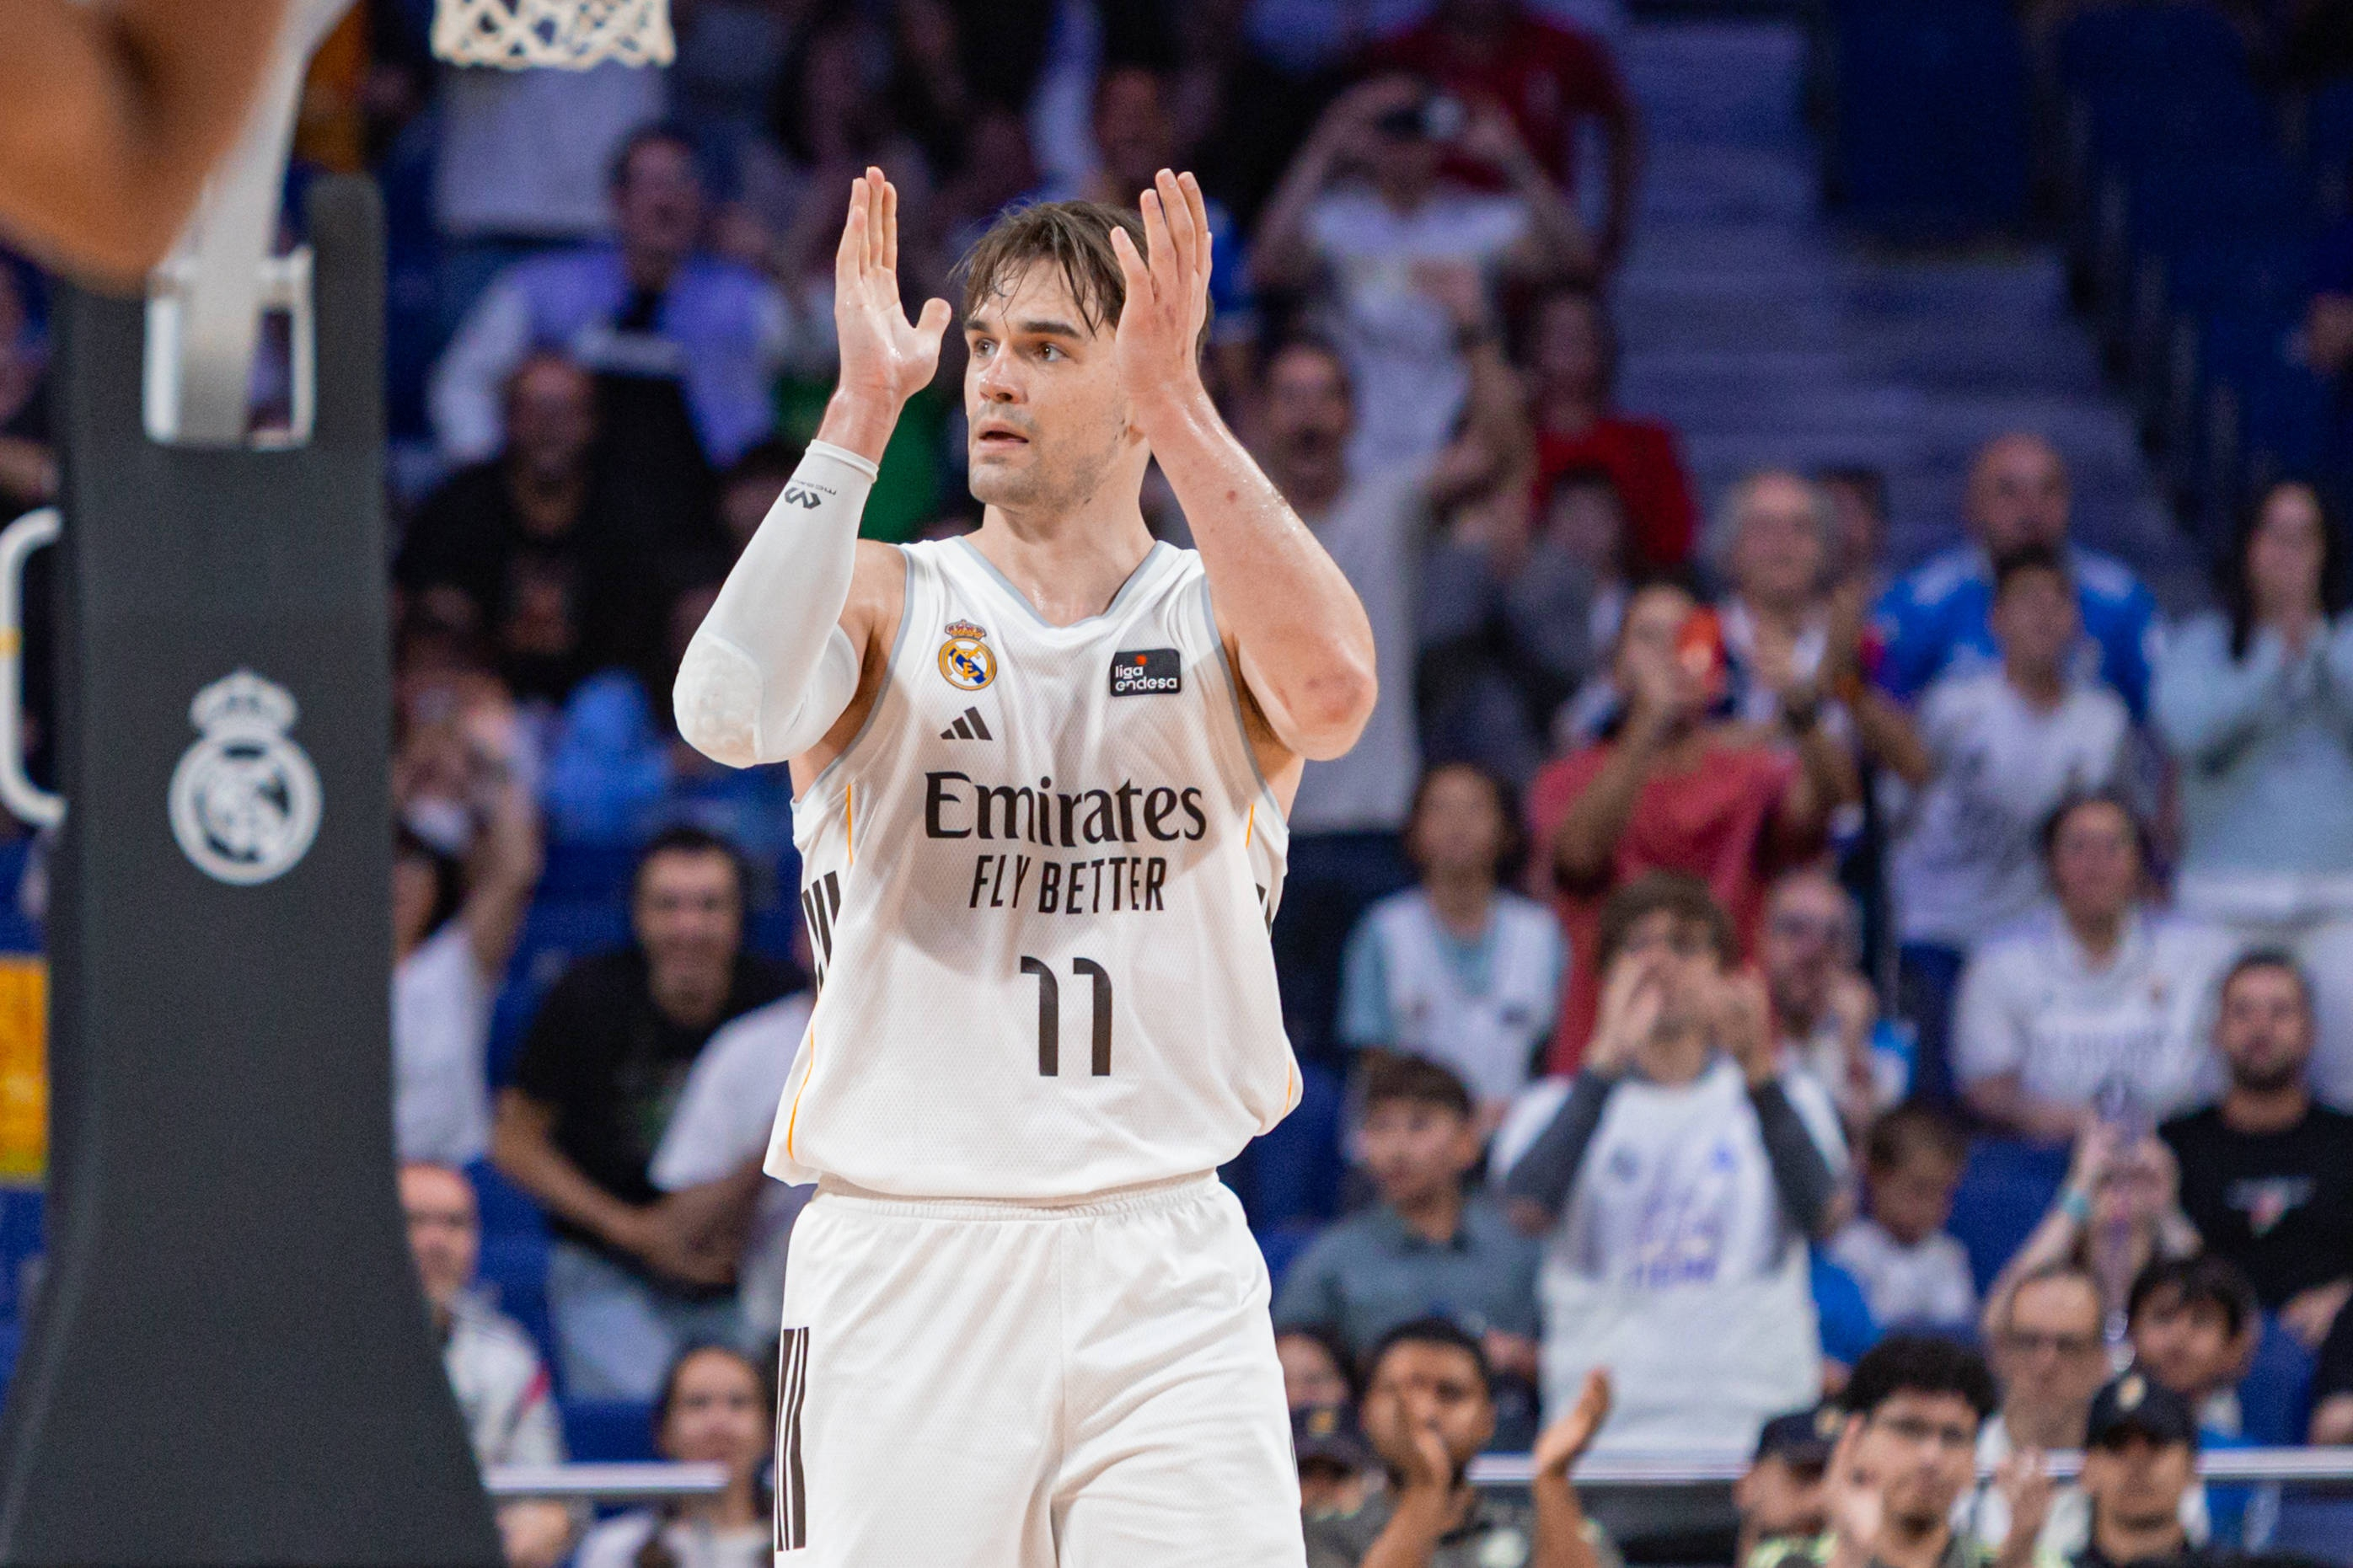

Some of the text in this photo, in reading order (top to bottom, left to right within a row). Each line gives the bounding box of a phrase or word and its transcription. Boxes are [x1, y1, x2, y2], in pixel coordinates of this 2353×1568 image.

[1115, 664, 1144, 679] liga
[1115, 676, 1177, 692] endesa
[925, 771, 1207, 848] Emirates
[969, 854, 1167, 915] FLY BETTER
[1020, 955, 1112, 1077] 11
